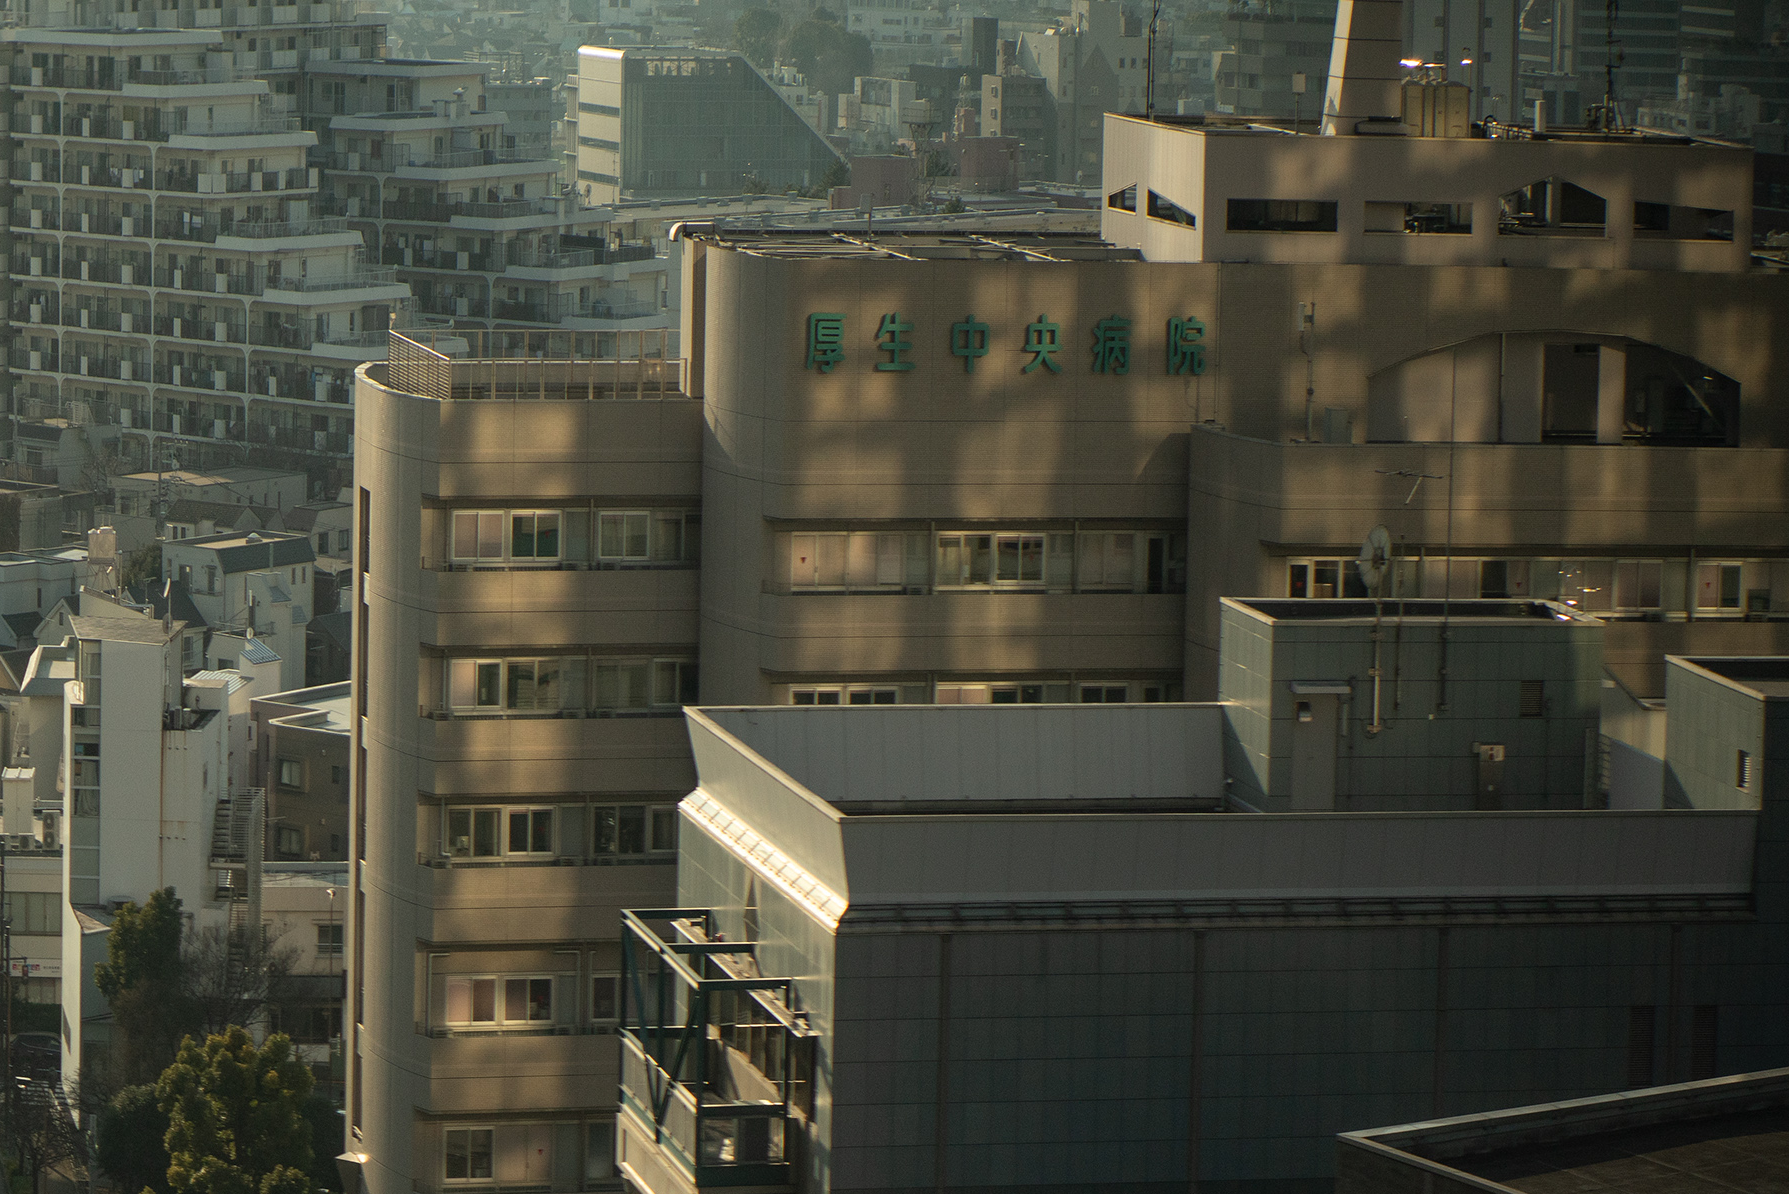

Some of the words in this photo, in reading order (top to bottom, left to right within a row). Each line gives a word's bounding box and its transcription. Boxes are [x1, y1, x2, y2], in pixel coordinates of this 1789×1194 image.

[806, 311, 1207, 375] 厚生中央病院
